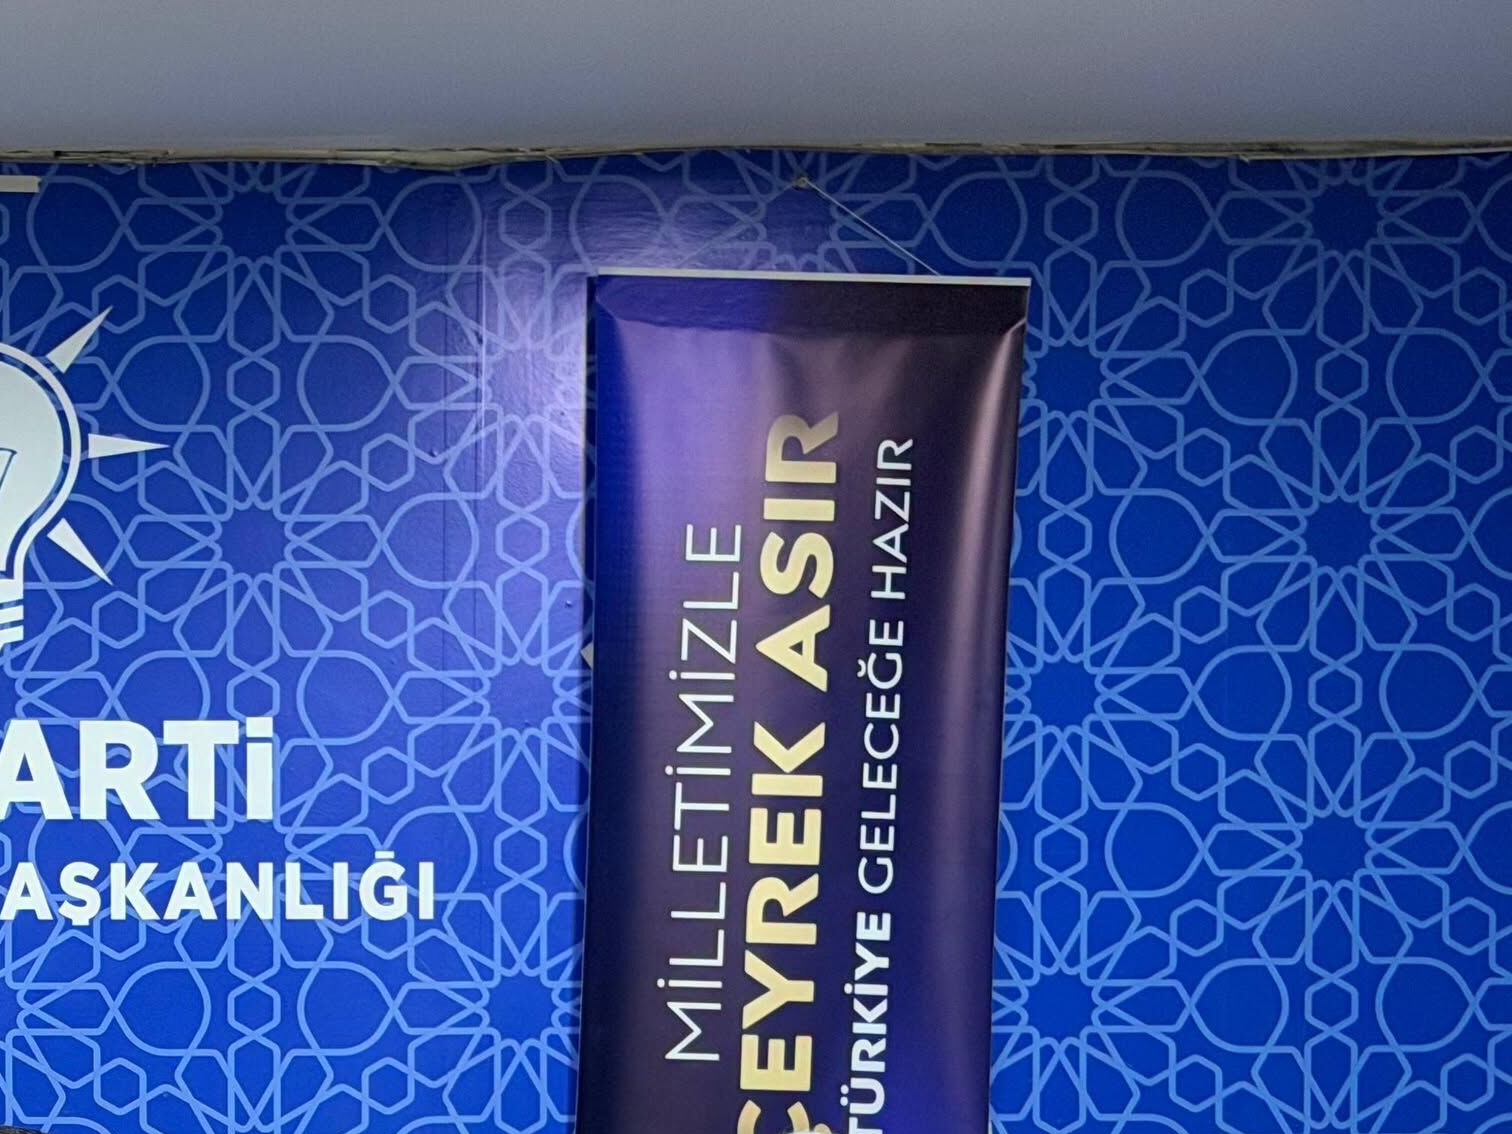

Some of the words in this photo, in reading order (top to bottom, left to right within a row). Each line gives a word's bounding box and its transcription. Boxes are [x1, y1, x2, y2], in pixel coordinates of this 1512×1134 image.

[756, 411, 839, 692] ASIR
[871, 438, 913, 599] HAZIR
[657, 524, 742, 1062] MİLLETİMİZLE
[857, 619, 904, 894] GELECEĞE
